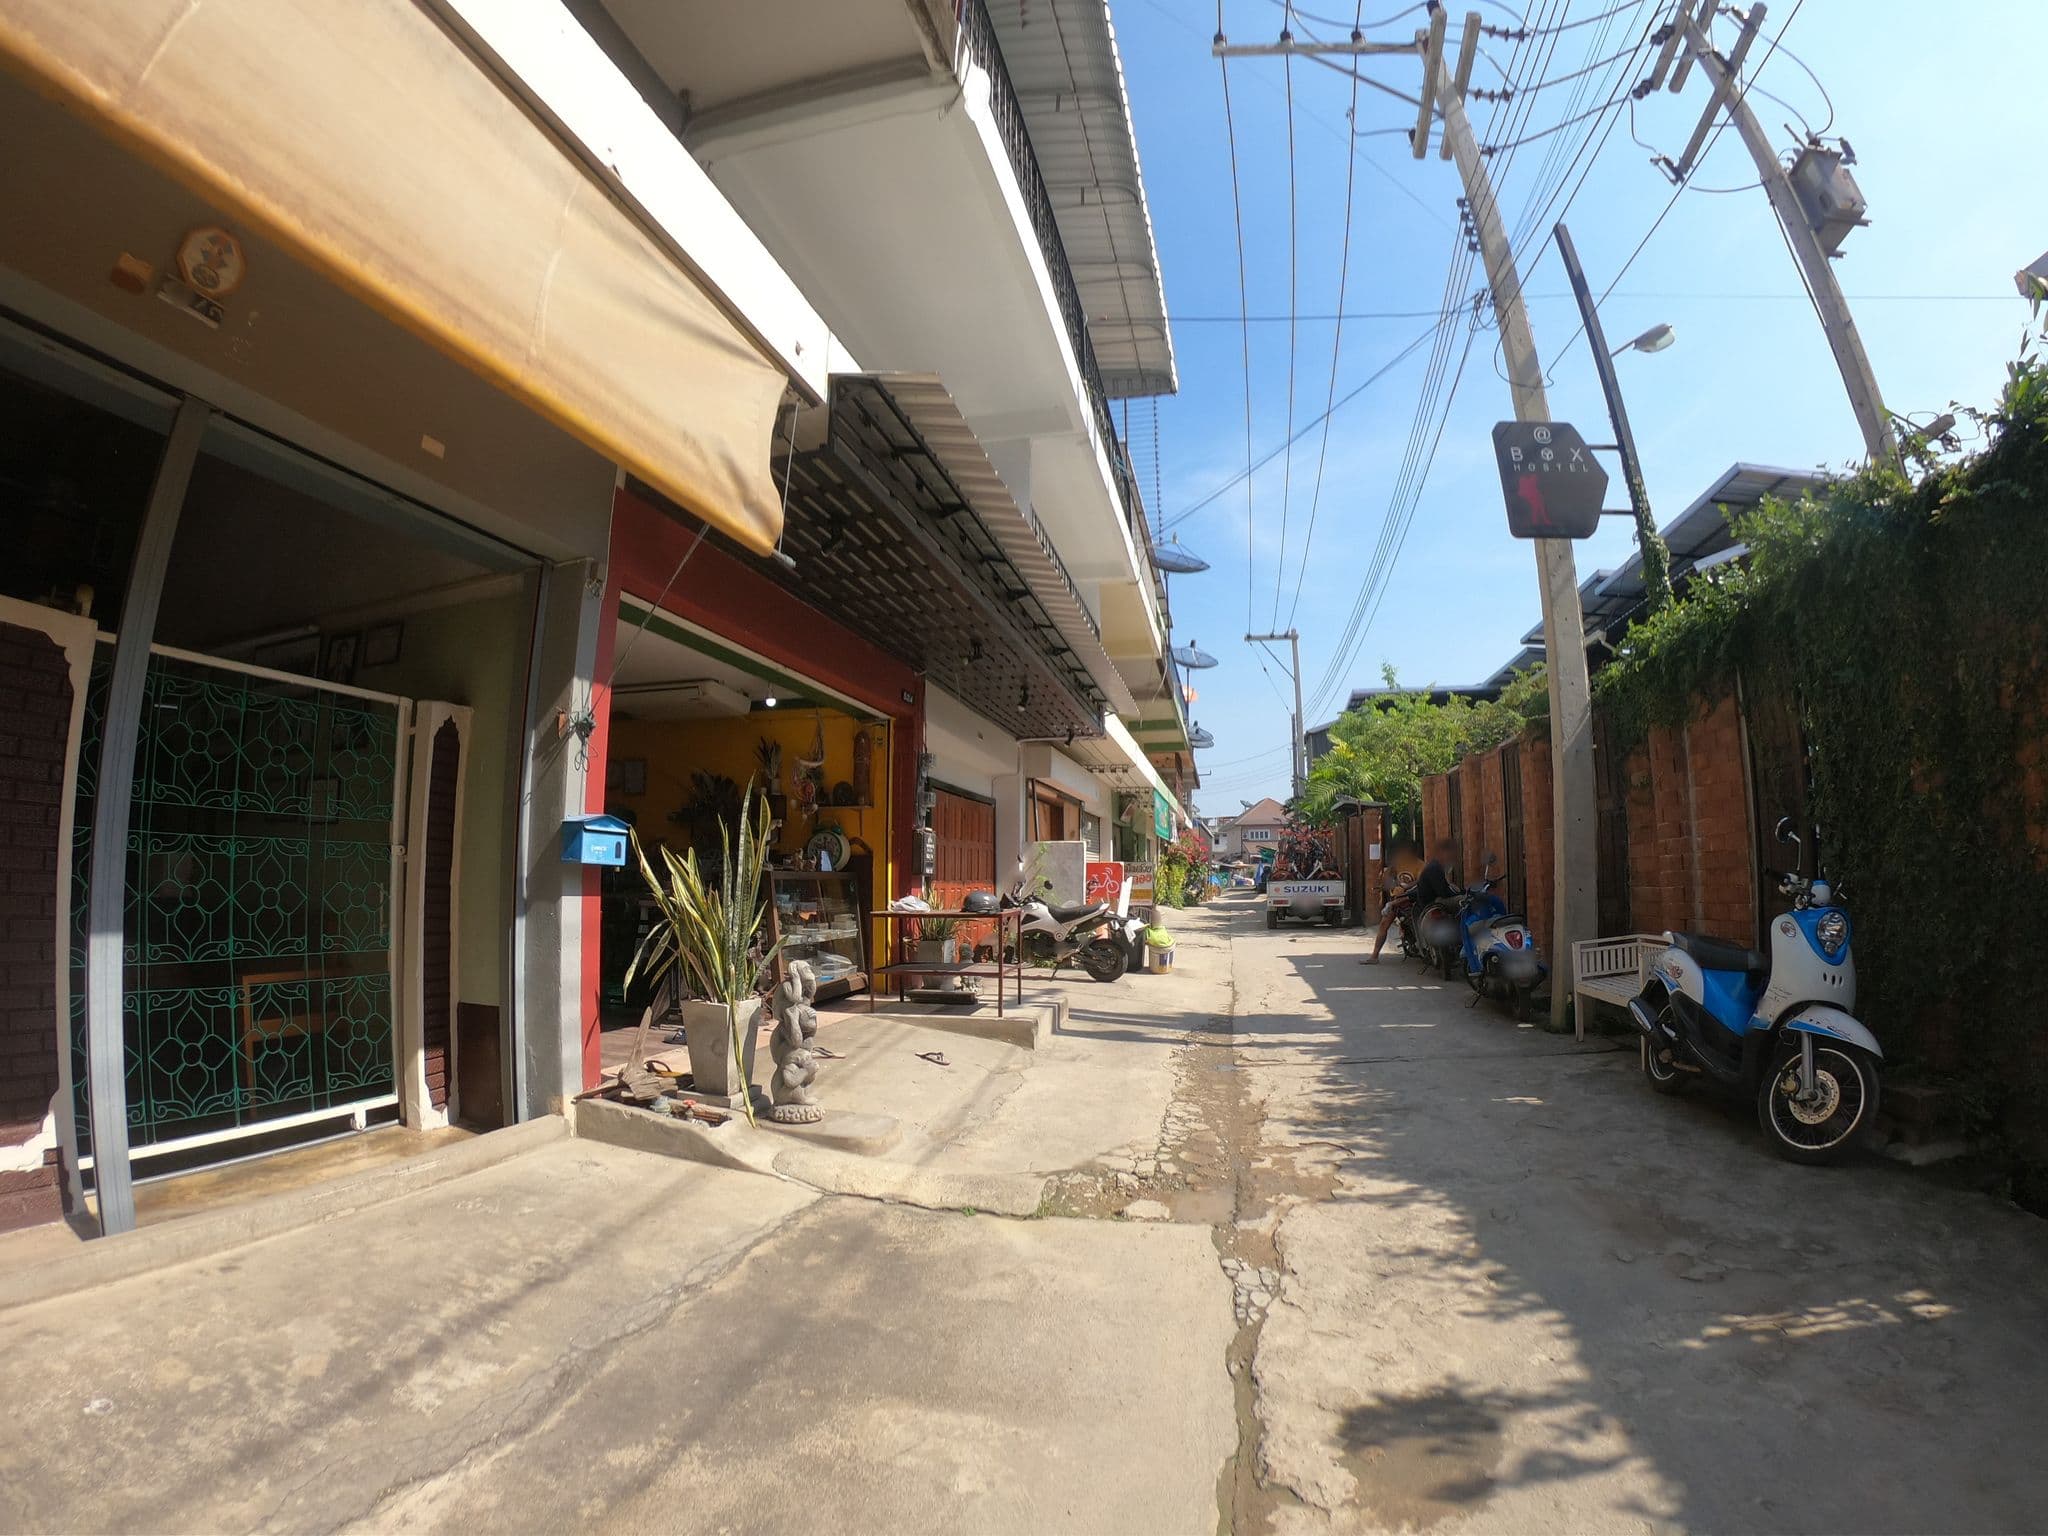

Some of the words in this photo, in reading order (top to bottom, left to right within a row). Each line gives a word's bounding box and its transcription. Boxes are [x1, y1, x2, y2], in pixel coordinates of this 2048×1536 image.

[1533, 426, 1552, 444] @
[1511, 446, 1584, 463] BOX
[1513, 462, 1589, 473] HOSTEL
[1283, 885, 1330, 894] SUZUKI
